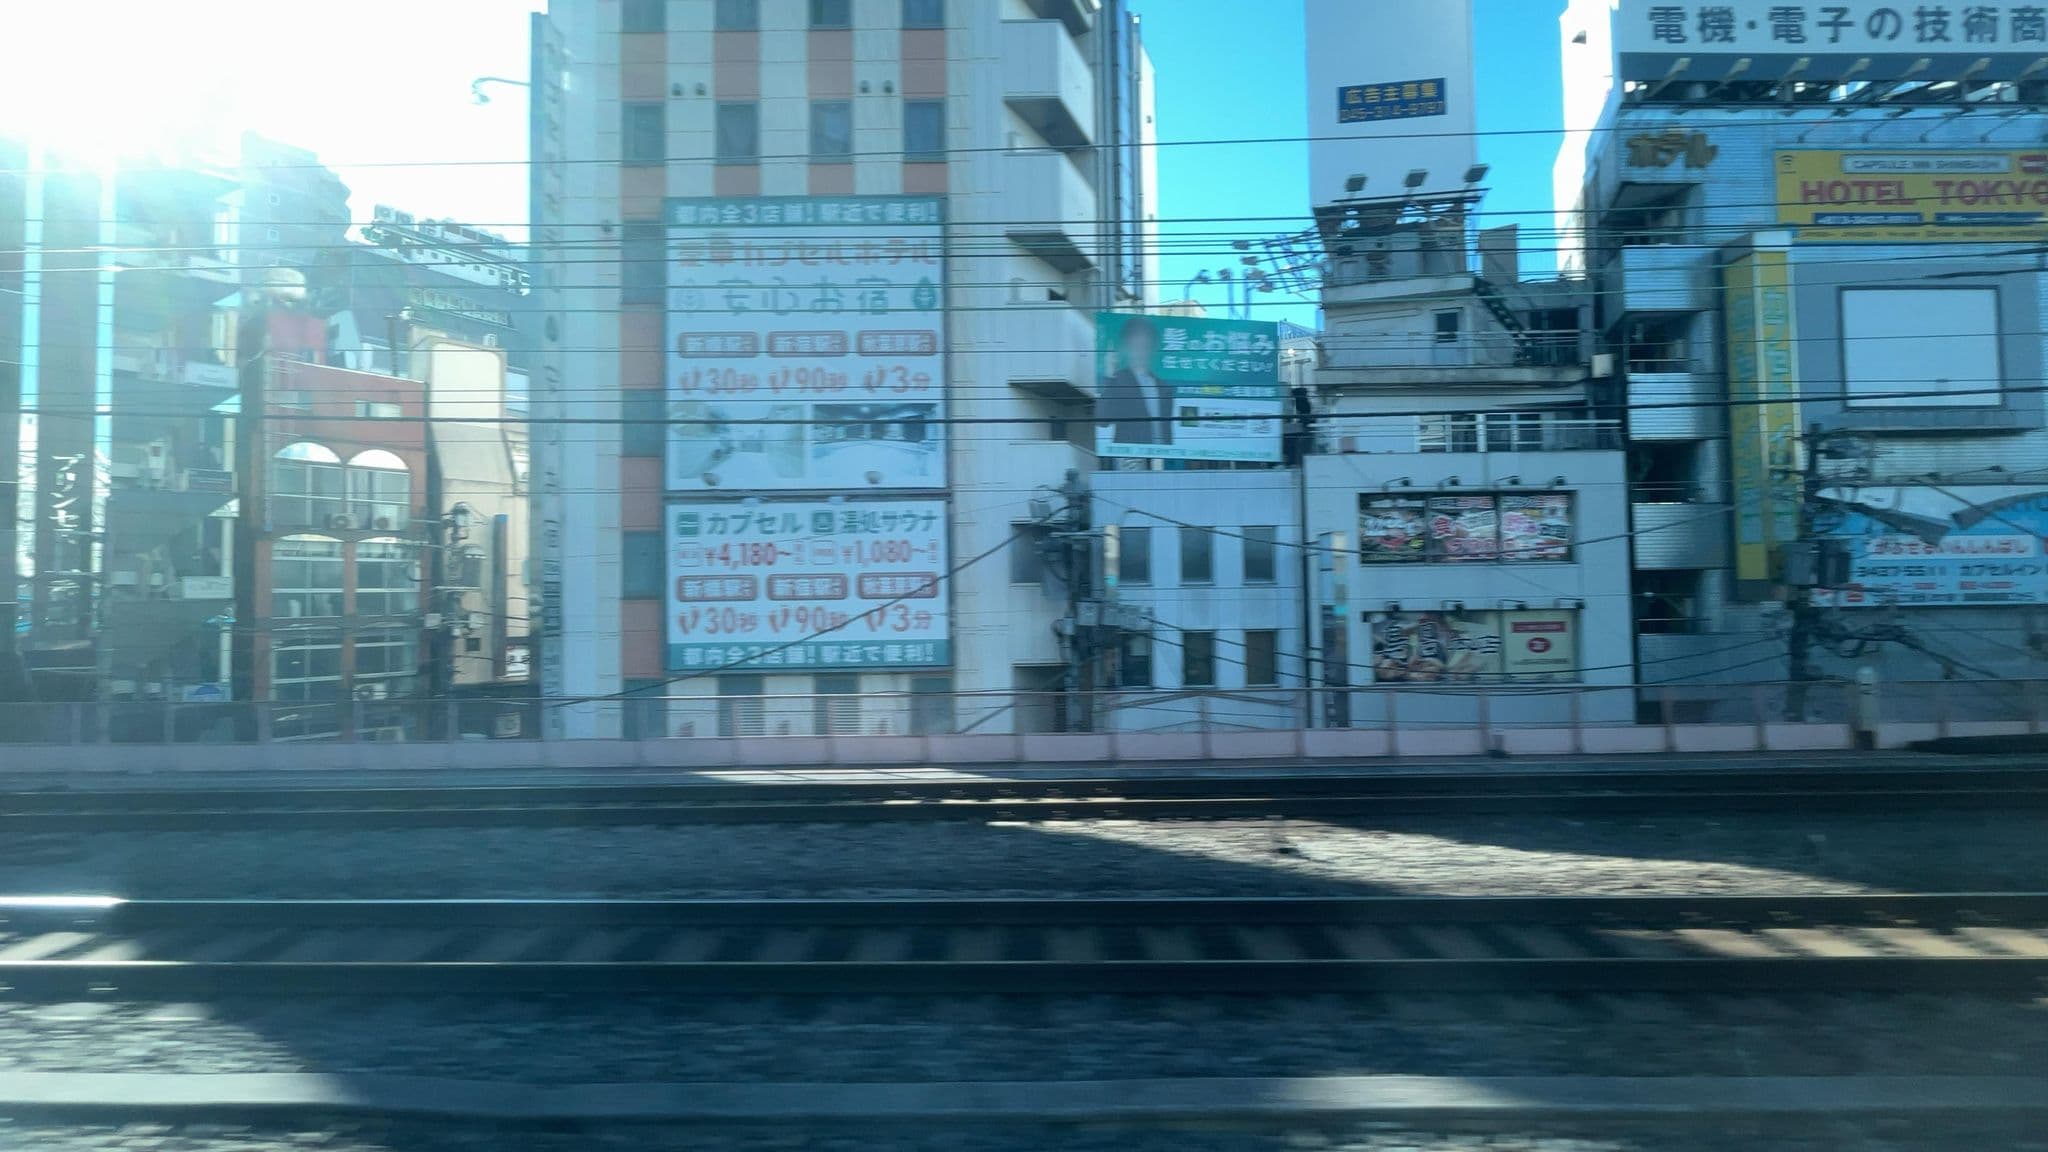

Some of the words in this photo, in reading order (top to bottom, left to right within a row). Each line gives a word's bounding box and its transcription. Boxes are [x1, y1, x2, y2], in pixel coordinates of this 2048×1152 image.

[1648, 6, 2047, 44] 電機・電子の技術商
[1801, 180, 1914, 206] HOTEL
[1934, 180, 2048, 205] TOKYO
[707, 511, 802, 534] カプセル
[891, 603, 932, 632] 3分
